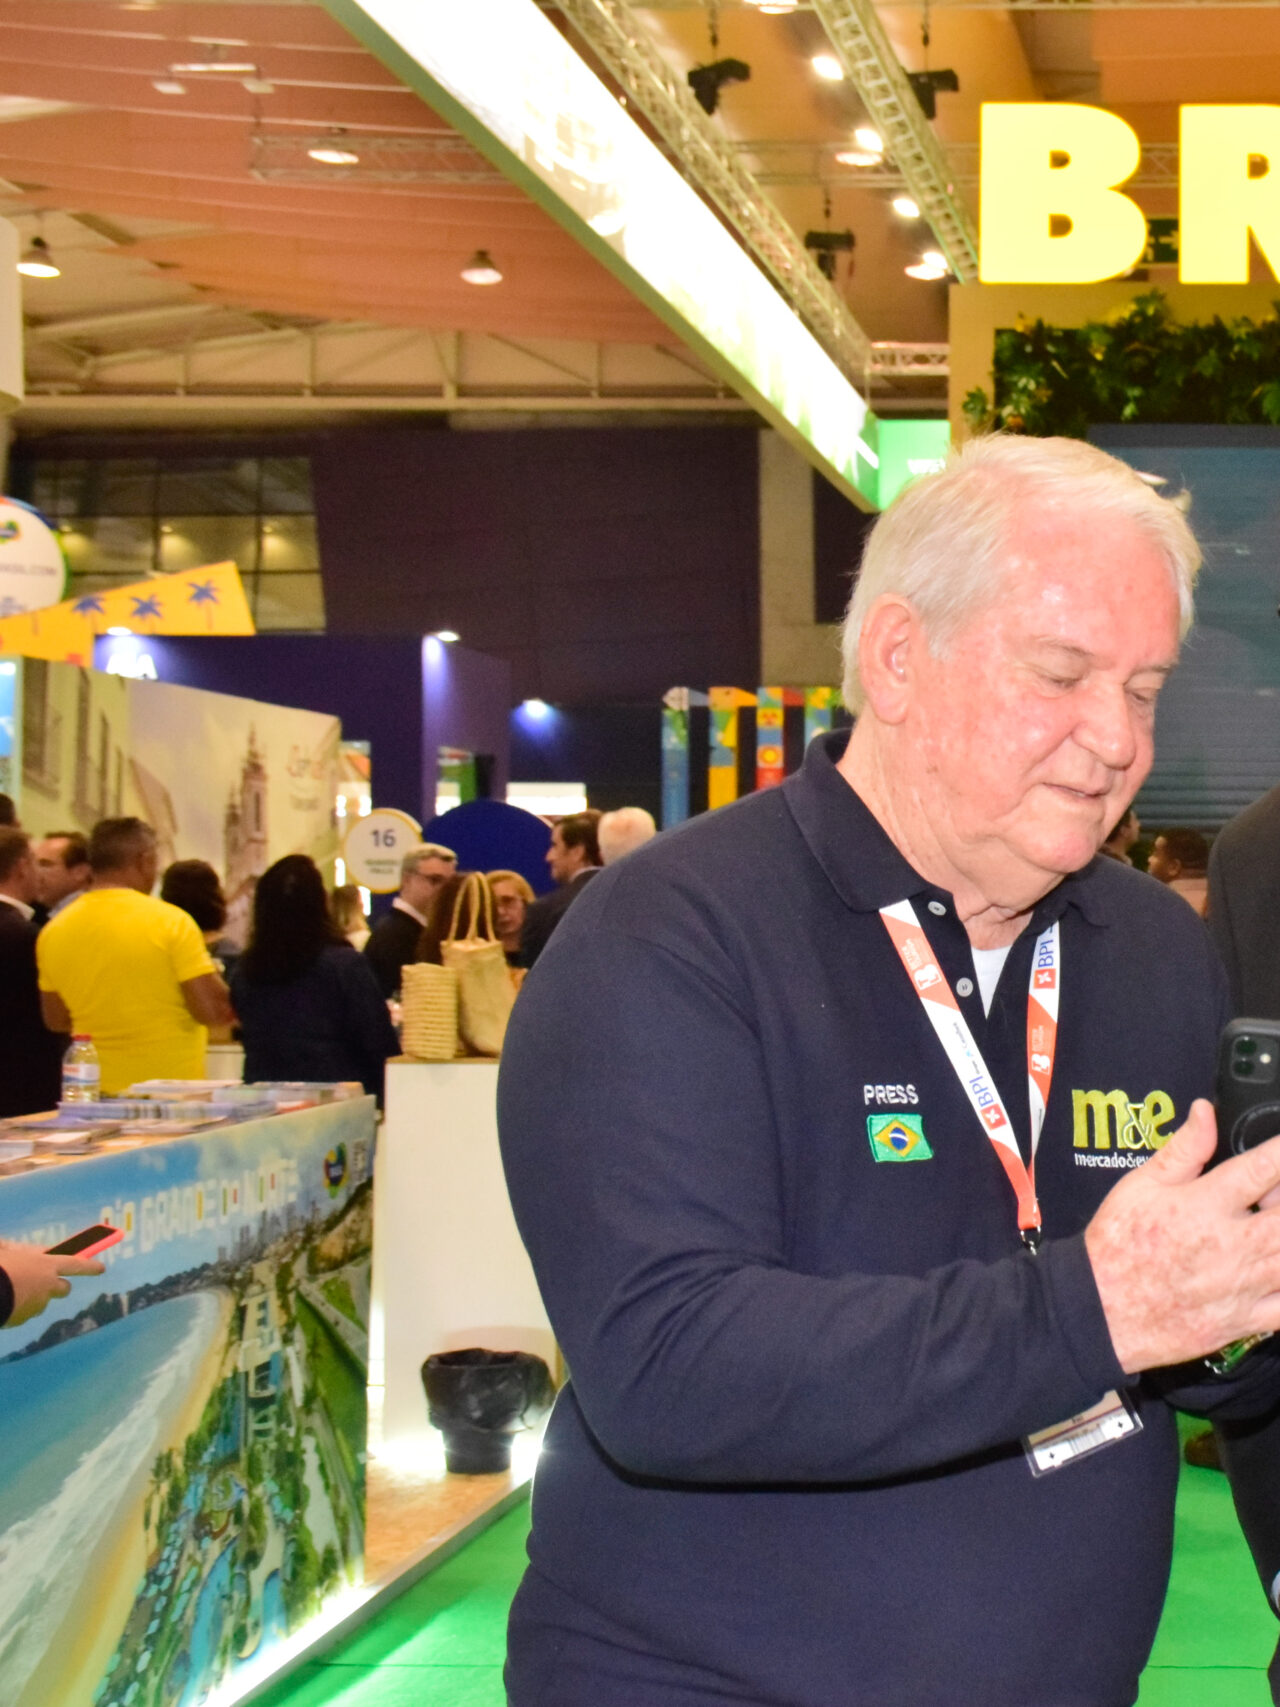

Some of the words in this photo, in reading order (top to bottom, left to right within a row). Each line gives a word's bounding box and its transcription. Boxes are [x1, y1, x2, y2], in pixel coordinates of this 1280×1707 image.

[370, 829, 397, 848] 16
[1037, 937, 1054, 968] BPI
[863, 1083, 919, 1106] PRESS
[969, 1075, 995, 1107] BPI
[1071, 1088, 1176, 1150] m&e
[1074, 1151, 1151, 1169] mercado&ev
